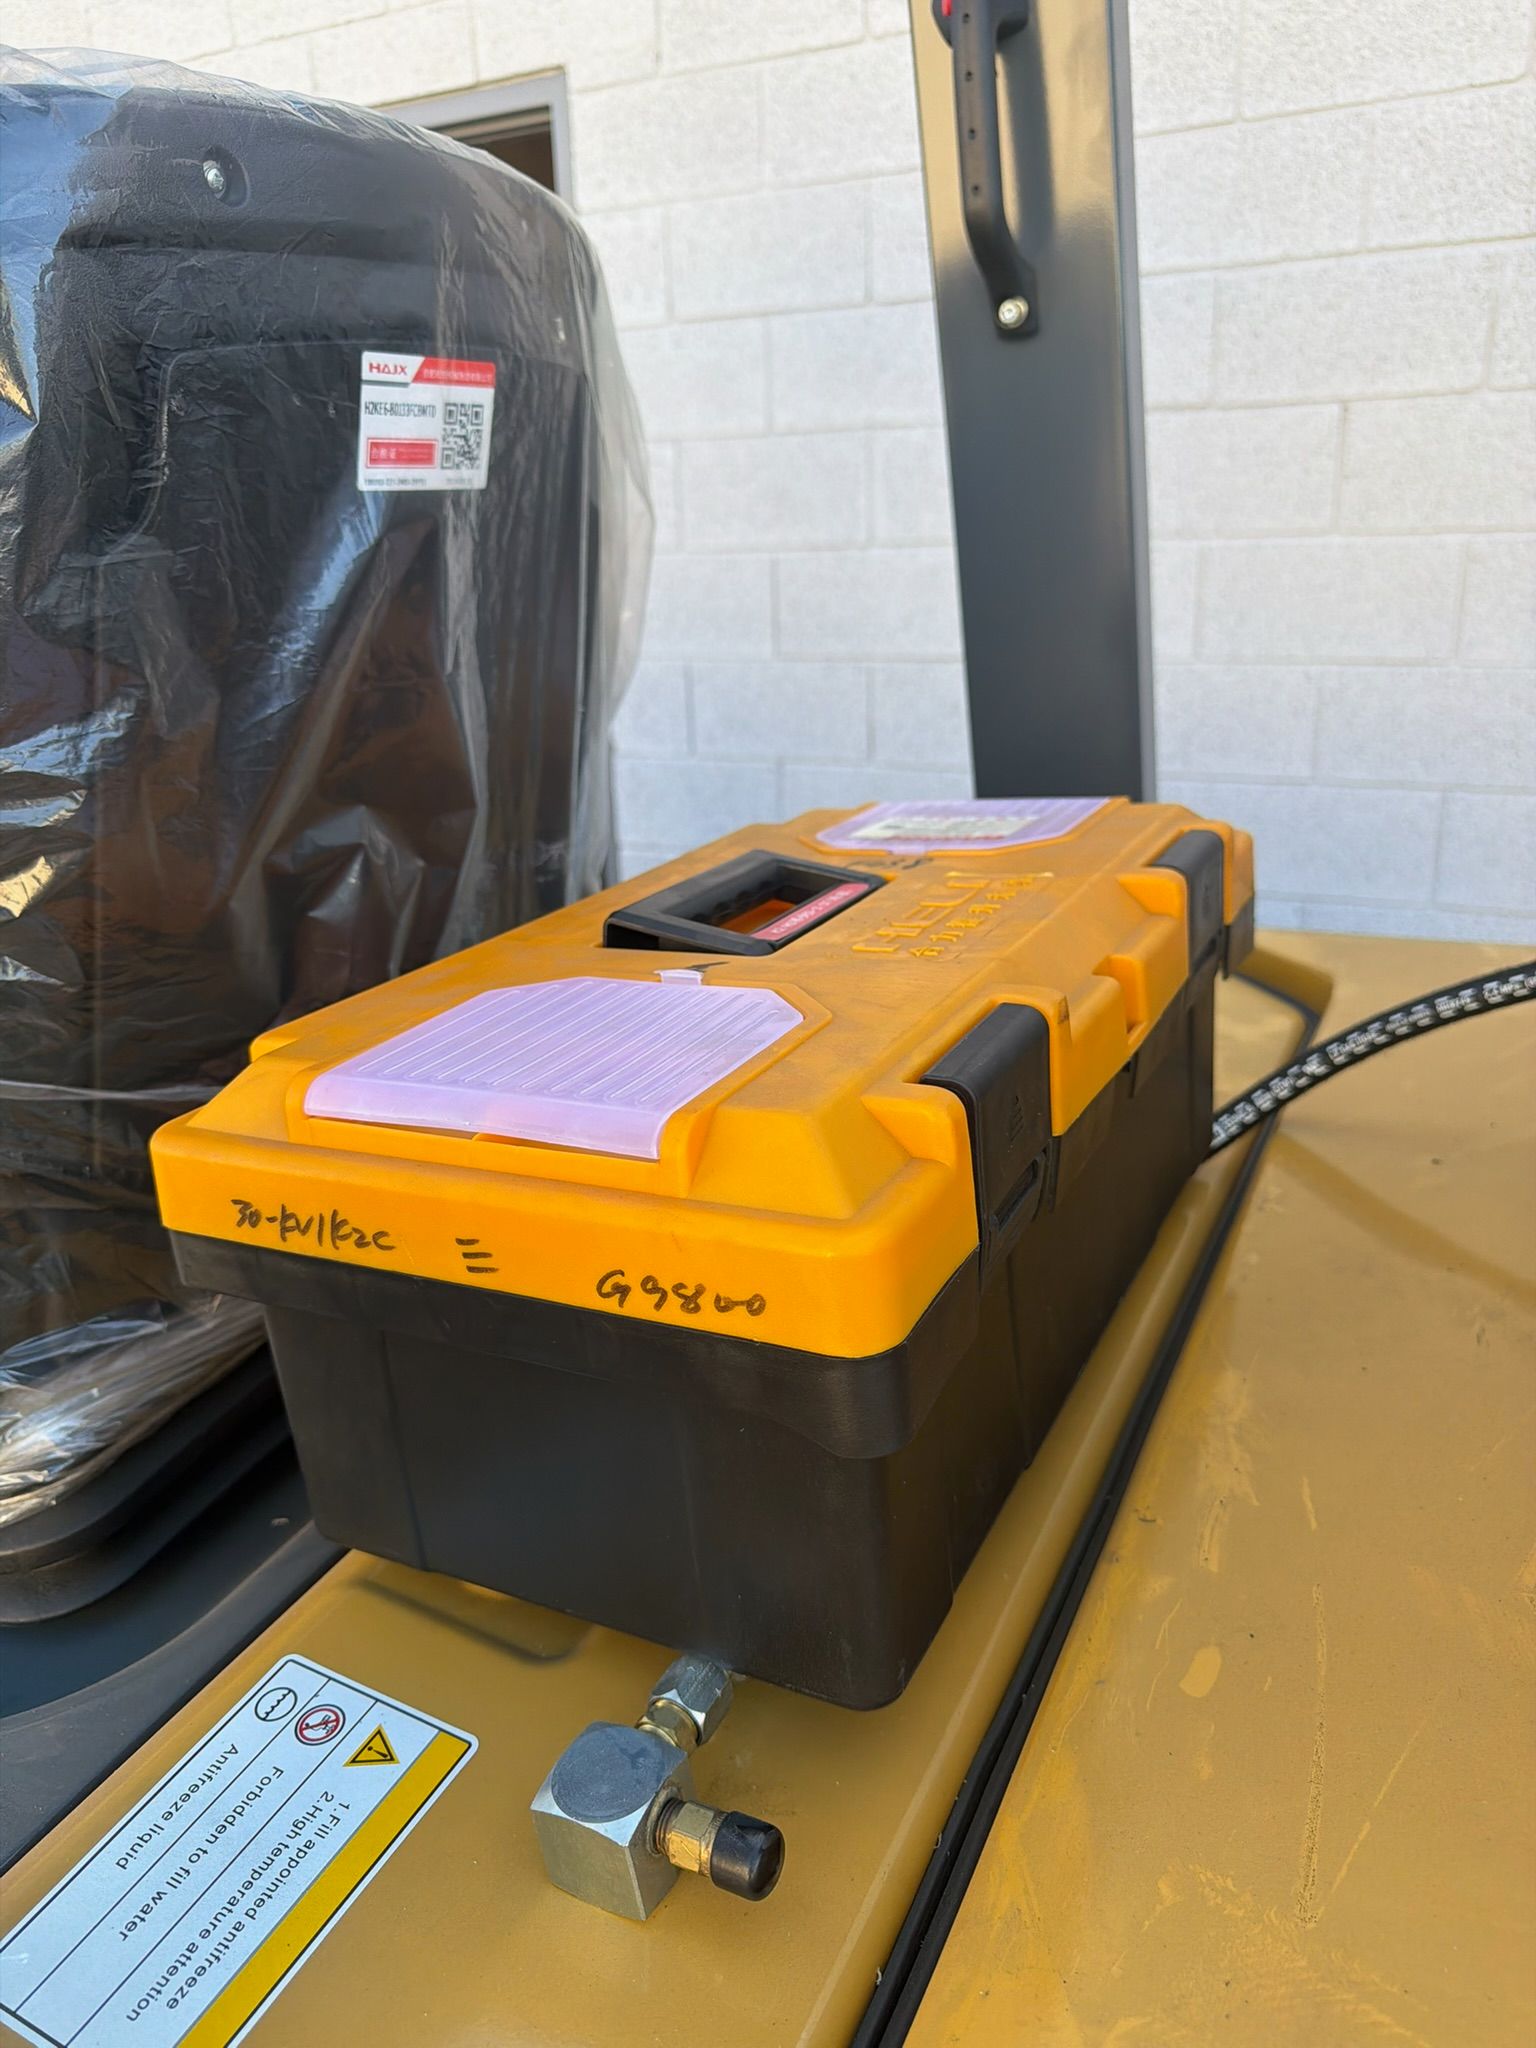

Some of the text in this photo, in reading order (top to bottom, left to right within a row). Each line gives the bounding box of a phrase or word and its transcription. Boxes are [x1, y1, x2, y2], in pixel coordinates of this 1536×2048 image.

[115, 1743, 239, 1870] Antifreeze liquid
[118, 1766, 285, 1942] Forbidden to fill water
[199, 1841, 290, 1940] temperature
[244, 1839, 316, 1921] appointed
[126, 1941, 199, 2022] attention
[166, 1920, 246, 2010] antifreeze
